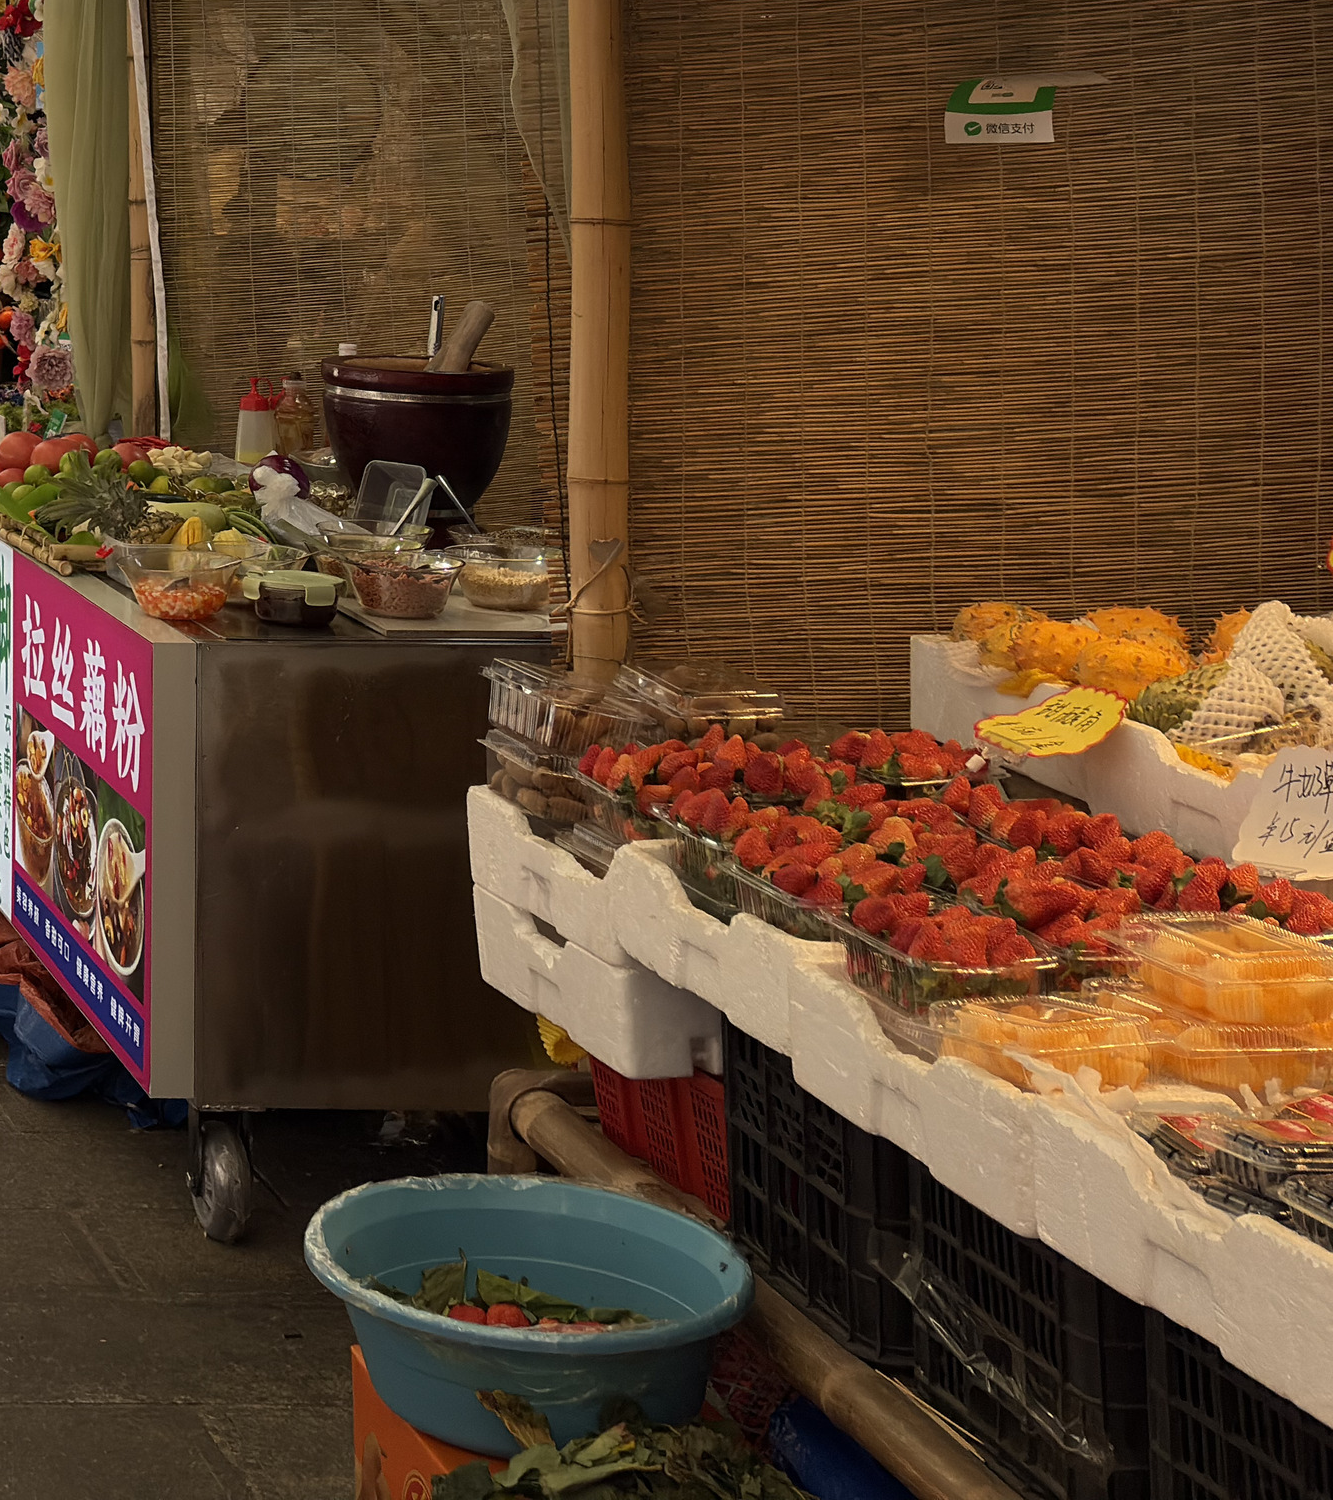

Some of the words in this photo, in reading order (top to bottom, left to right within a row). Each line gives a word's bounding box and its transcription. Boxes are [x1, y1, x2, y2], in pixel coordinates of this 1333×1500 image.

[985, 121, 1035, 136] 微信支付
[20, 593, 146, 794] 拉丝藕粉
[2, 703, 13, 861] 云南特色
[44, 917, 70, 964] 香甜可口
